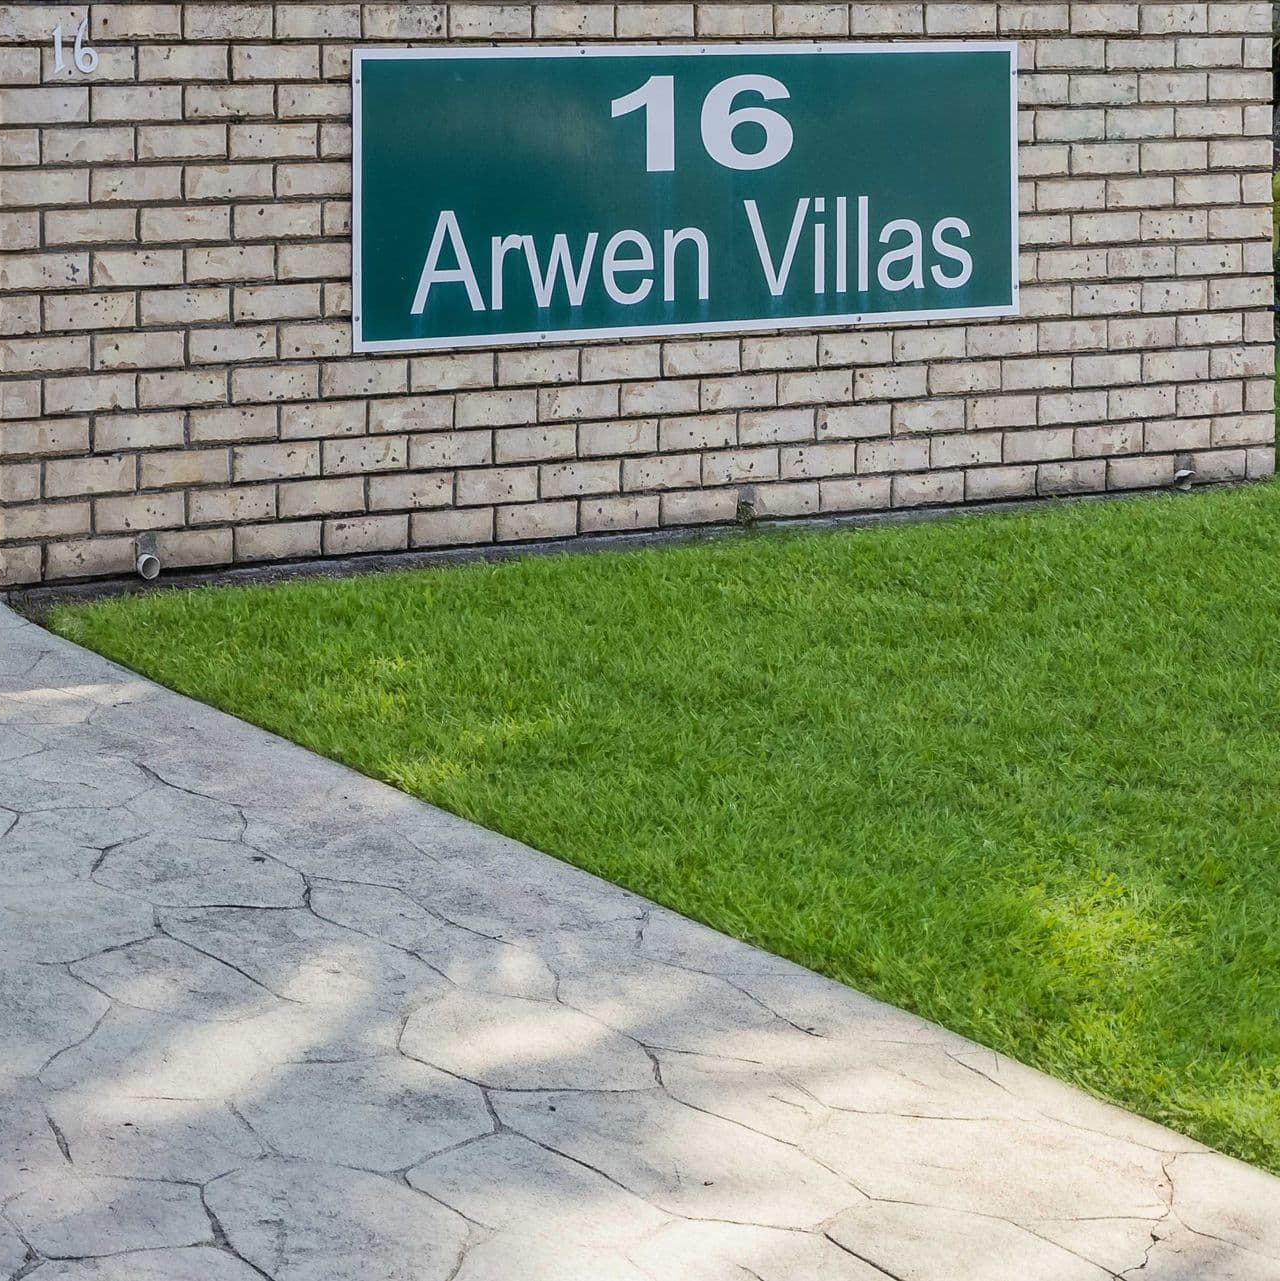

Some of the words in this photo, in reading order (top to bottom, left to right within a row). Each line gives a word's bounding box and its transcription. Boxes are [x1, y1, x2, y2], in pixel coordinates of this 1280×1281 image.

[52, 17, 99, 74] 16
[610, 73, 794, 173] 16
[410, 210, 709, 315] Arwen
[743, 195, 973, 297] Villas
